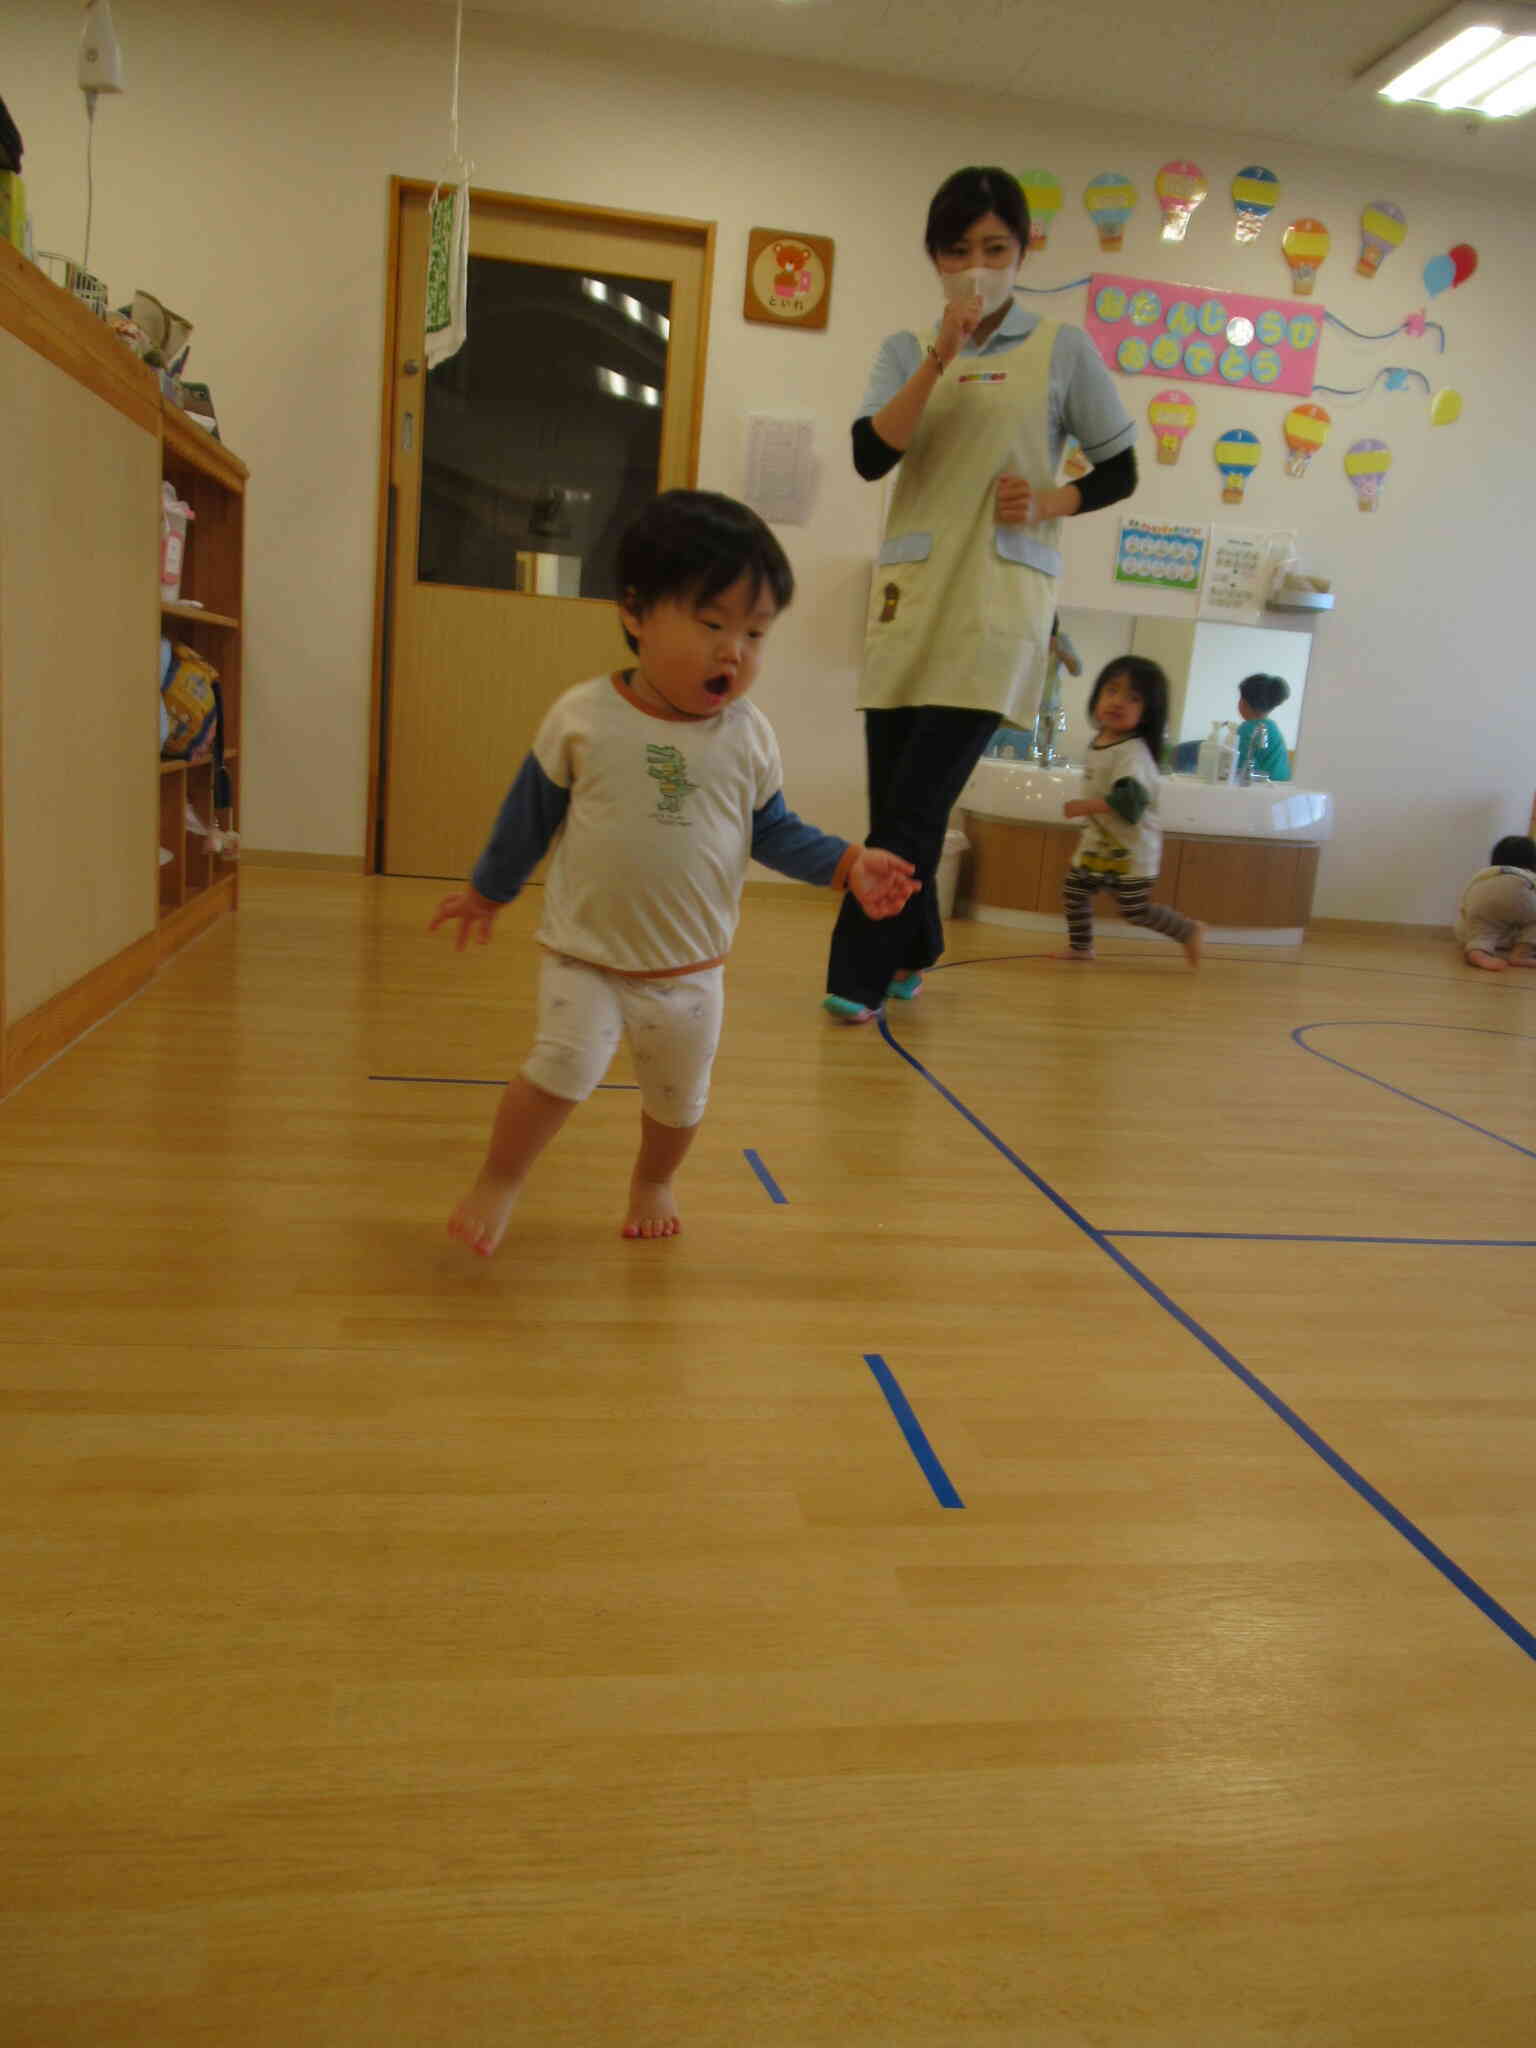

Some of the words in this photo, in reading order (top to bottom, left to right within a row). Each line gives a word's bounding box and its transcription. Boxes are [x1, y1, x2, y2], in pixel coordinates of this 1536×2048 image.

[1098, 288, 1317, 349] おたんじうび
[1118, 337, 1281, 382] おめでとう
